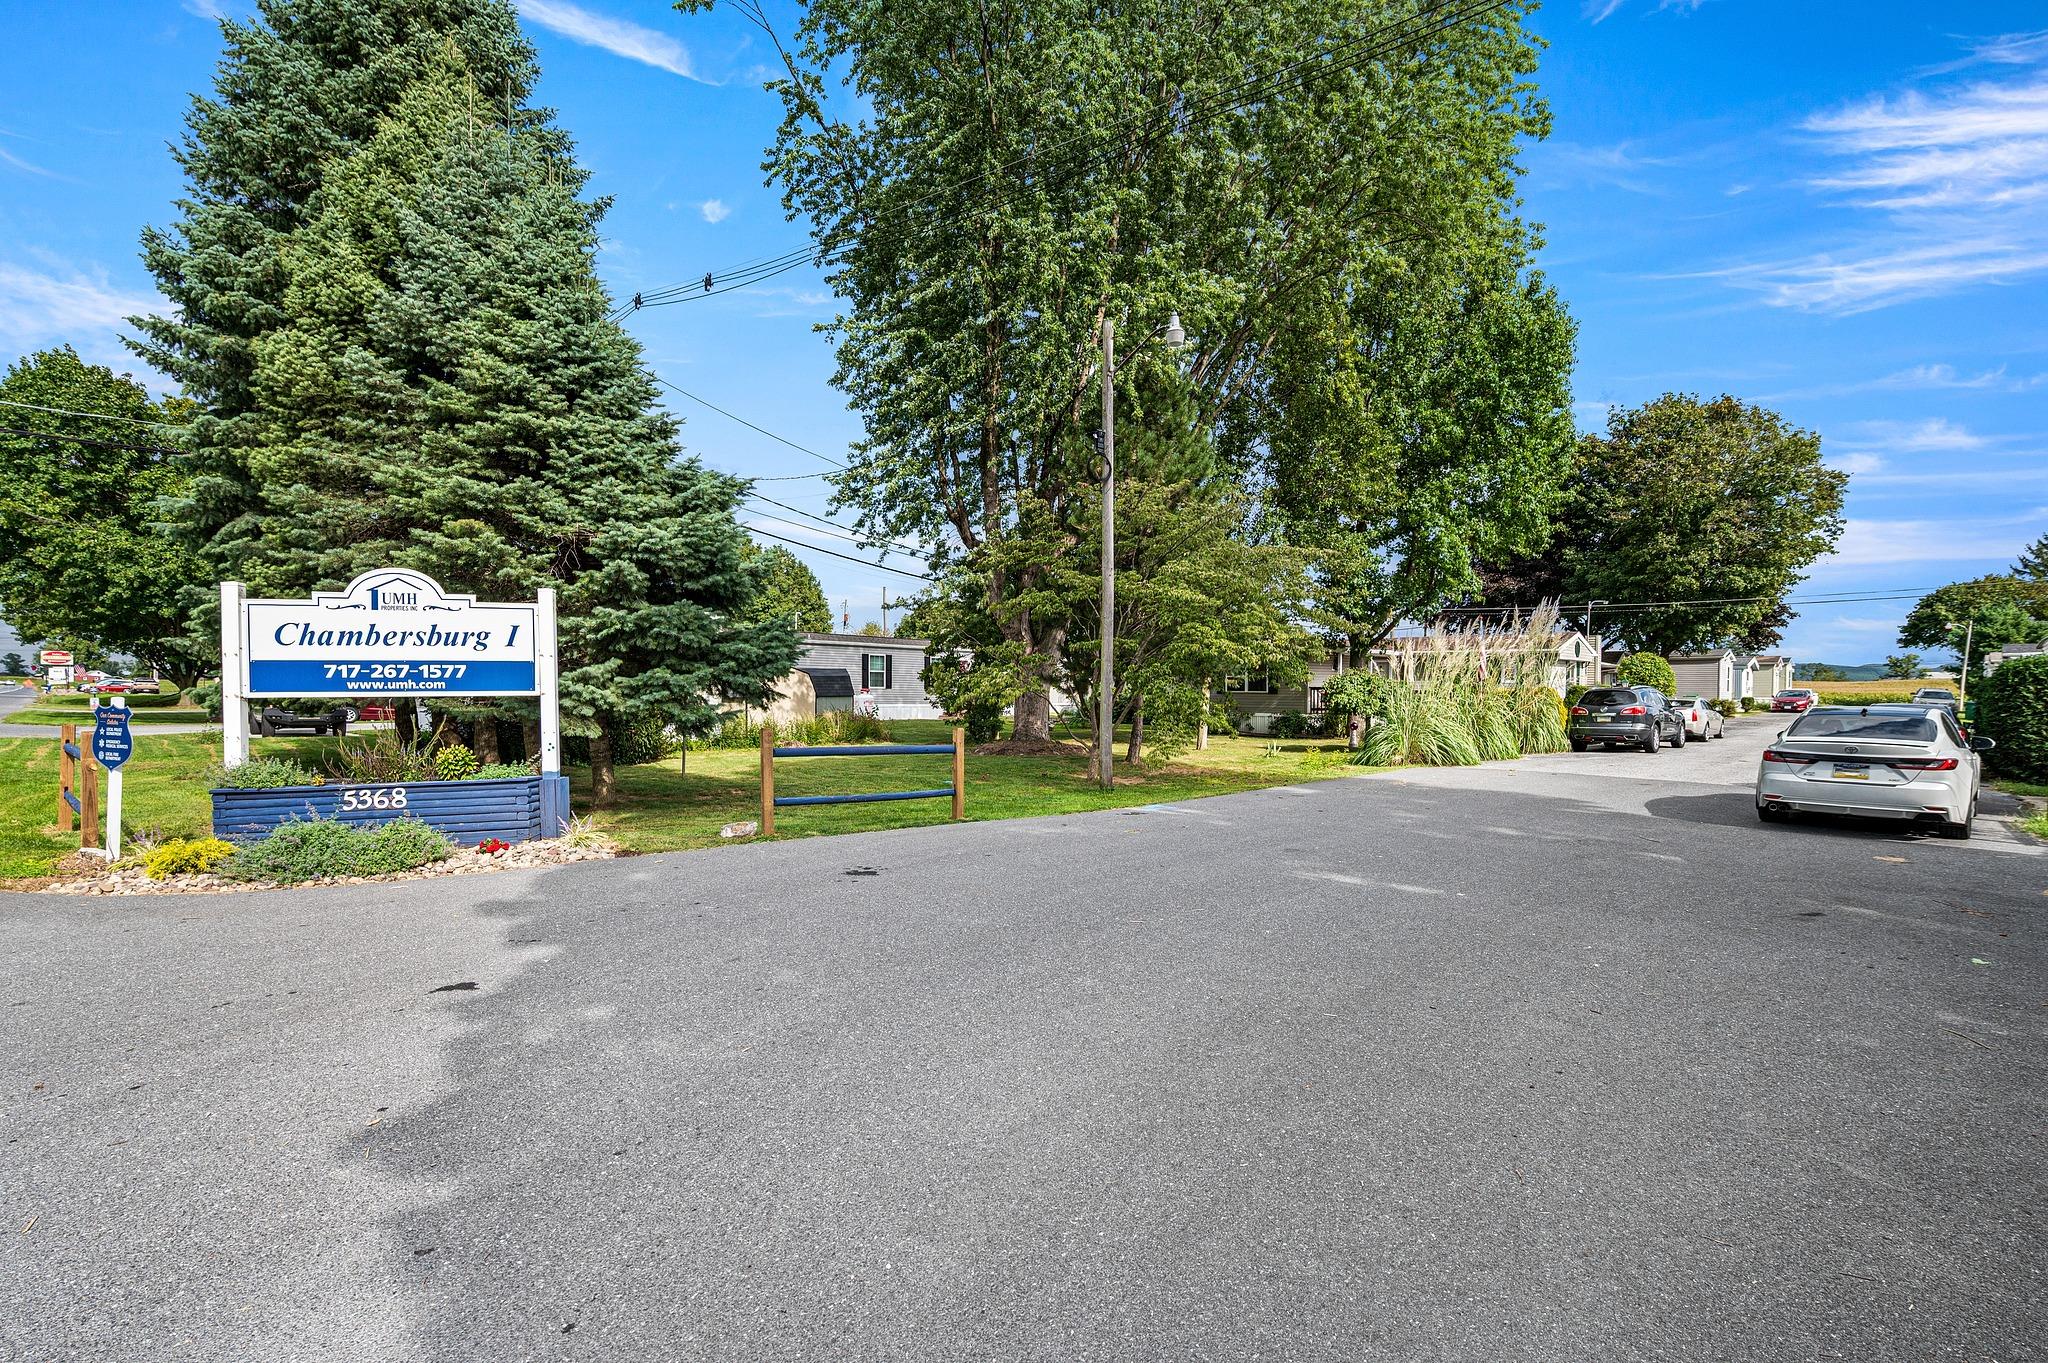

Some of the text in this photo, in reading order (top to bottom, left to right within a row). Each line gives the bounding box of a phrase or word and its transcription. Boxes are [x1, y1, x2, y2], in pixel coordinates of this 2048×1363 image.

[382, 592, 417, 605] UMH
[274, 622, 521, 652] Chambersburg I
[323, 663, 467, 679] 717-267-1577
[346, 679, 446, 690] www.umh.com
[342, 787, 408, 812] 5368
